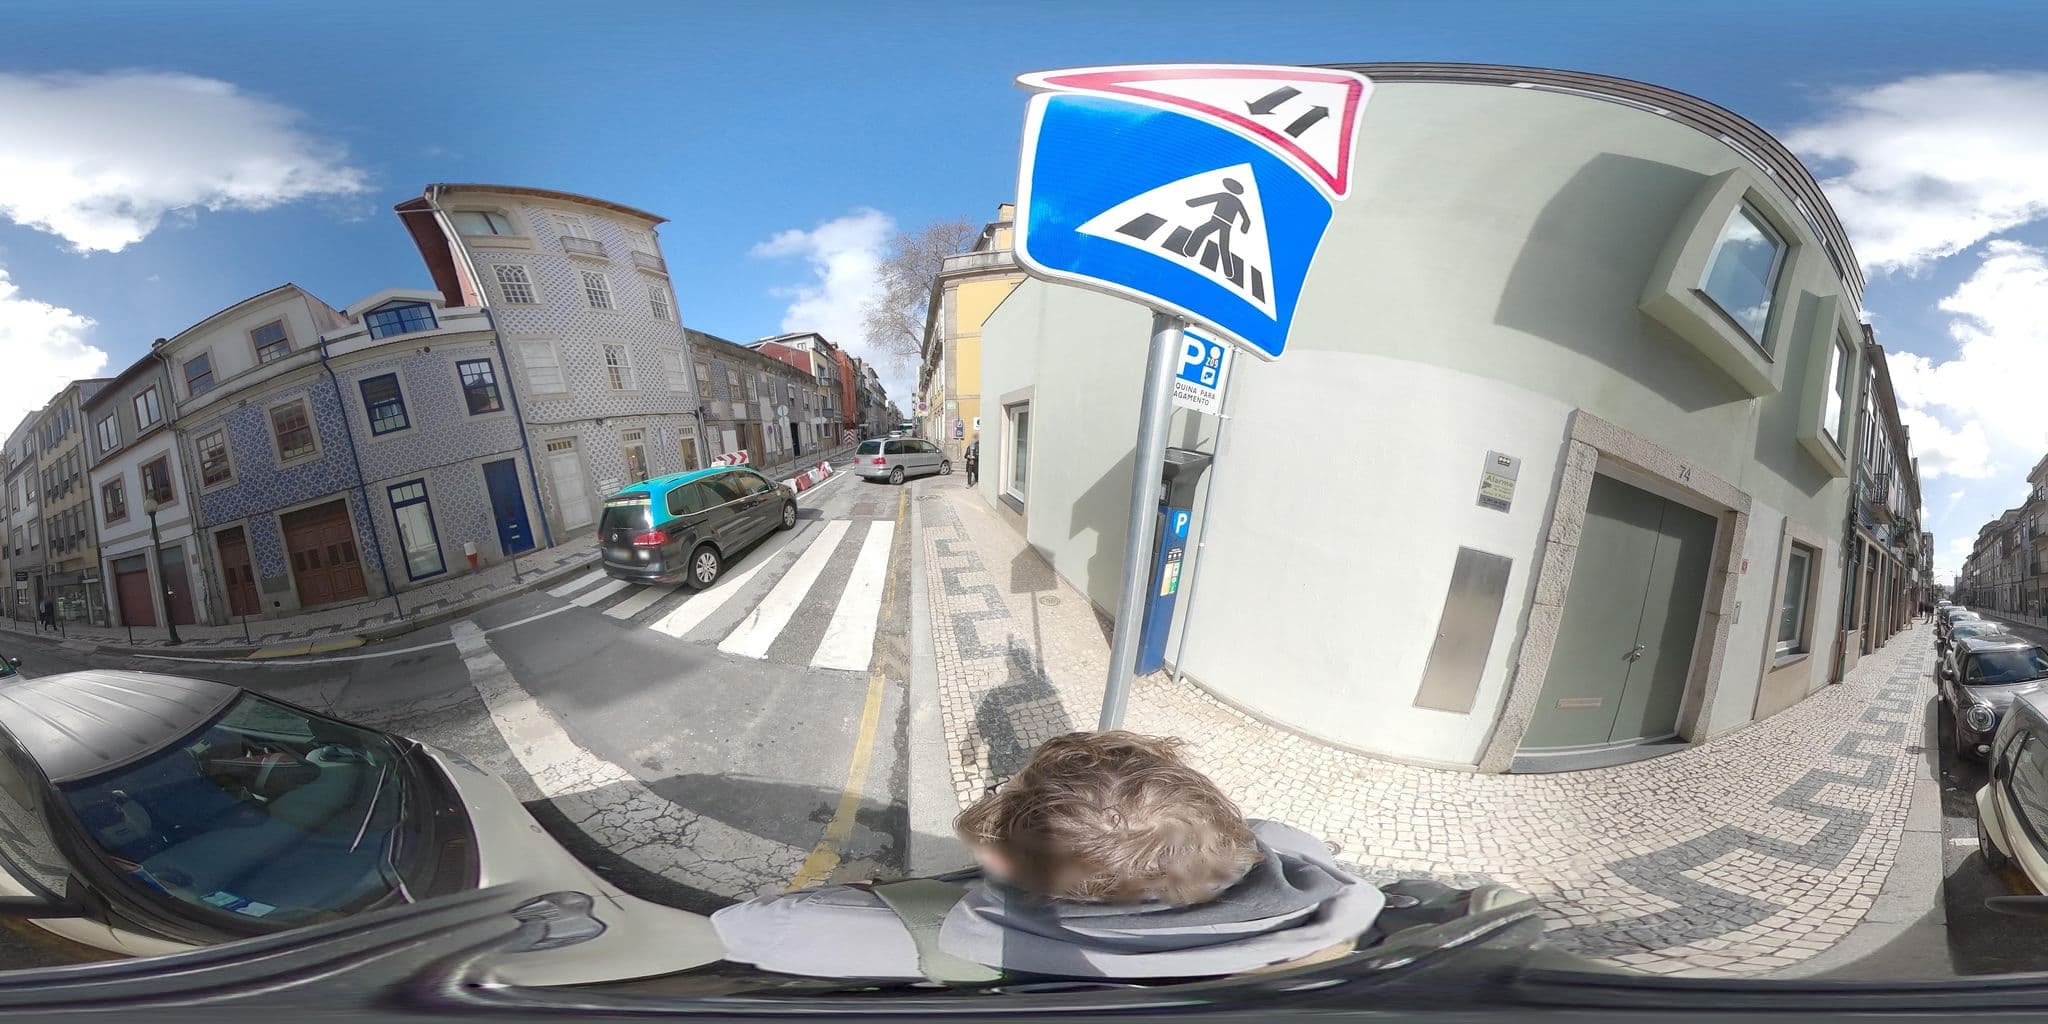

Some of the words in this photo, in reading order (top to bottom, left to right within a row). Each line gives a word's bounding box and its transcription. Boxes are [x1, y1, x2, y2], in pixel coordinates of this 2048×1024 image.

[1177, 334, 1206, 375] P
[1173, 390, 1210, 406] AGAMENTO
[1175, 382, 1197, 395] QUINA
[1200, 389, 1216, 400] PARA
[1679, 465, 1691, 482] 74
[1176, 513, 1188, 534] P
